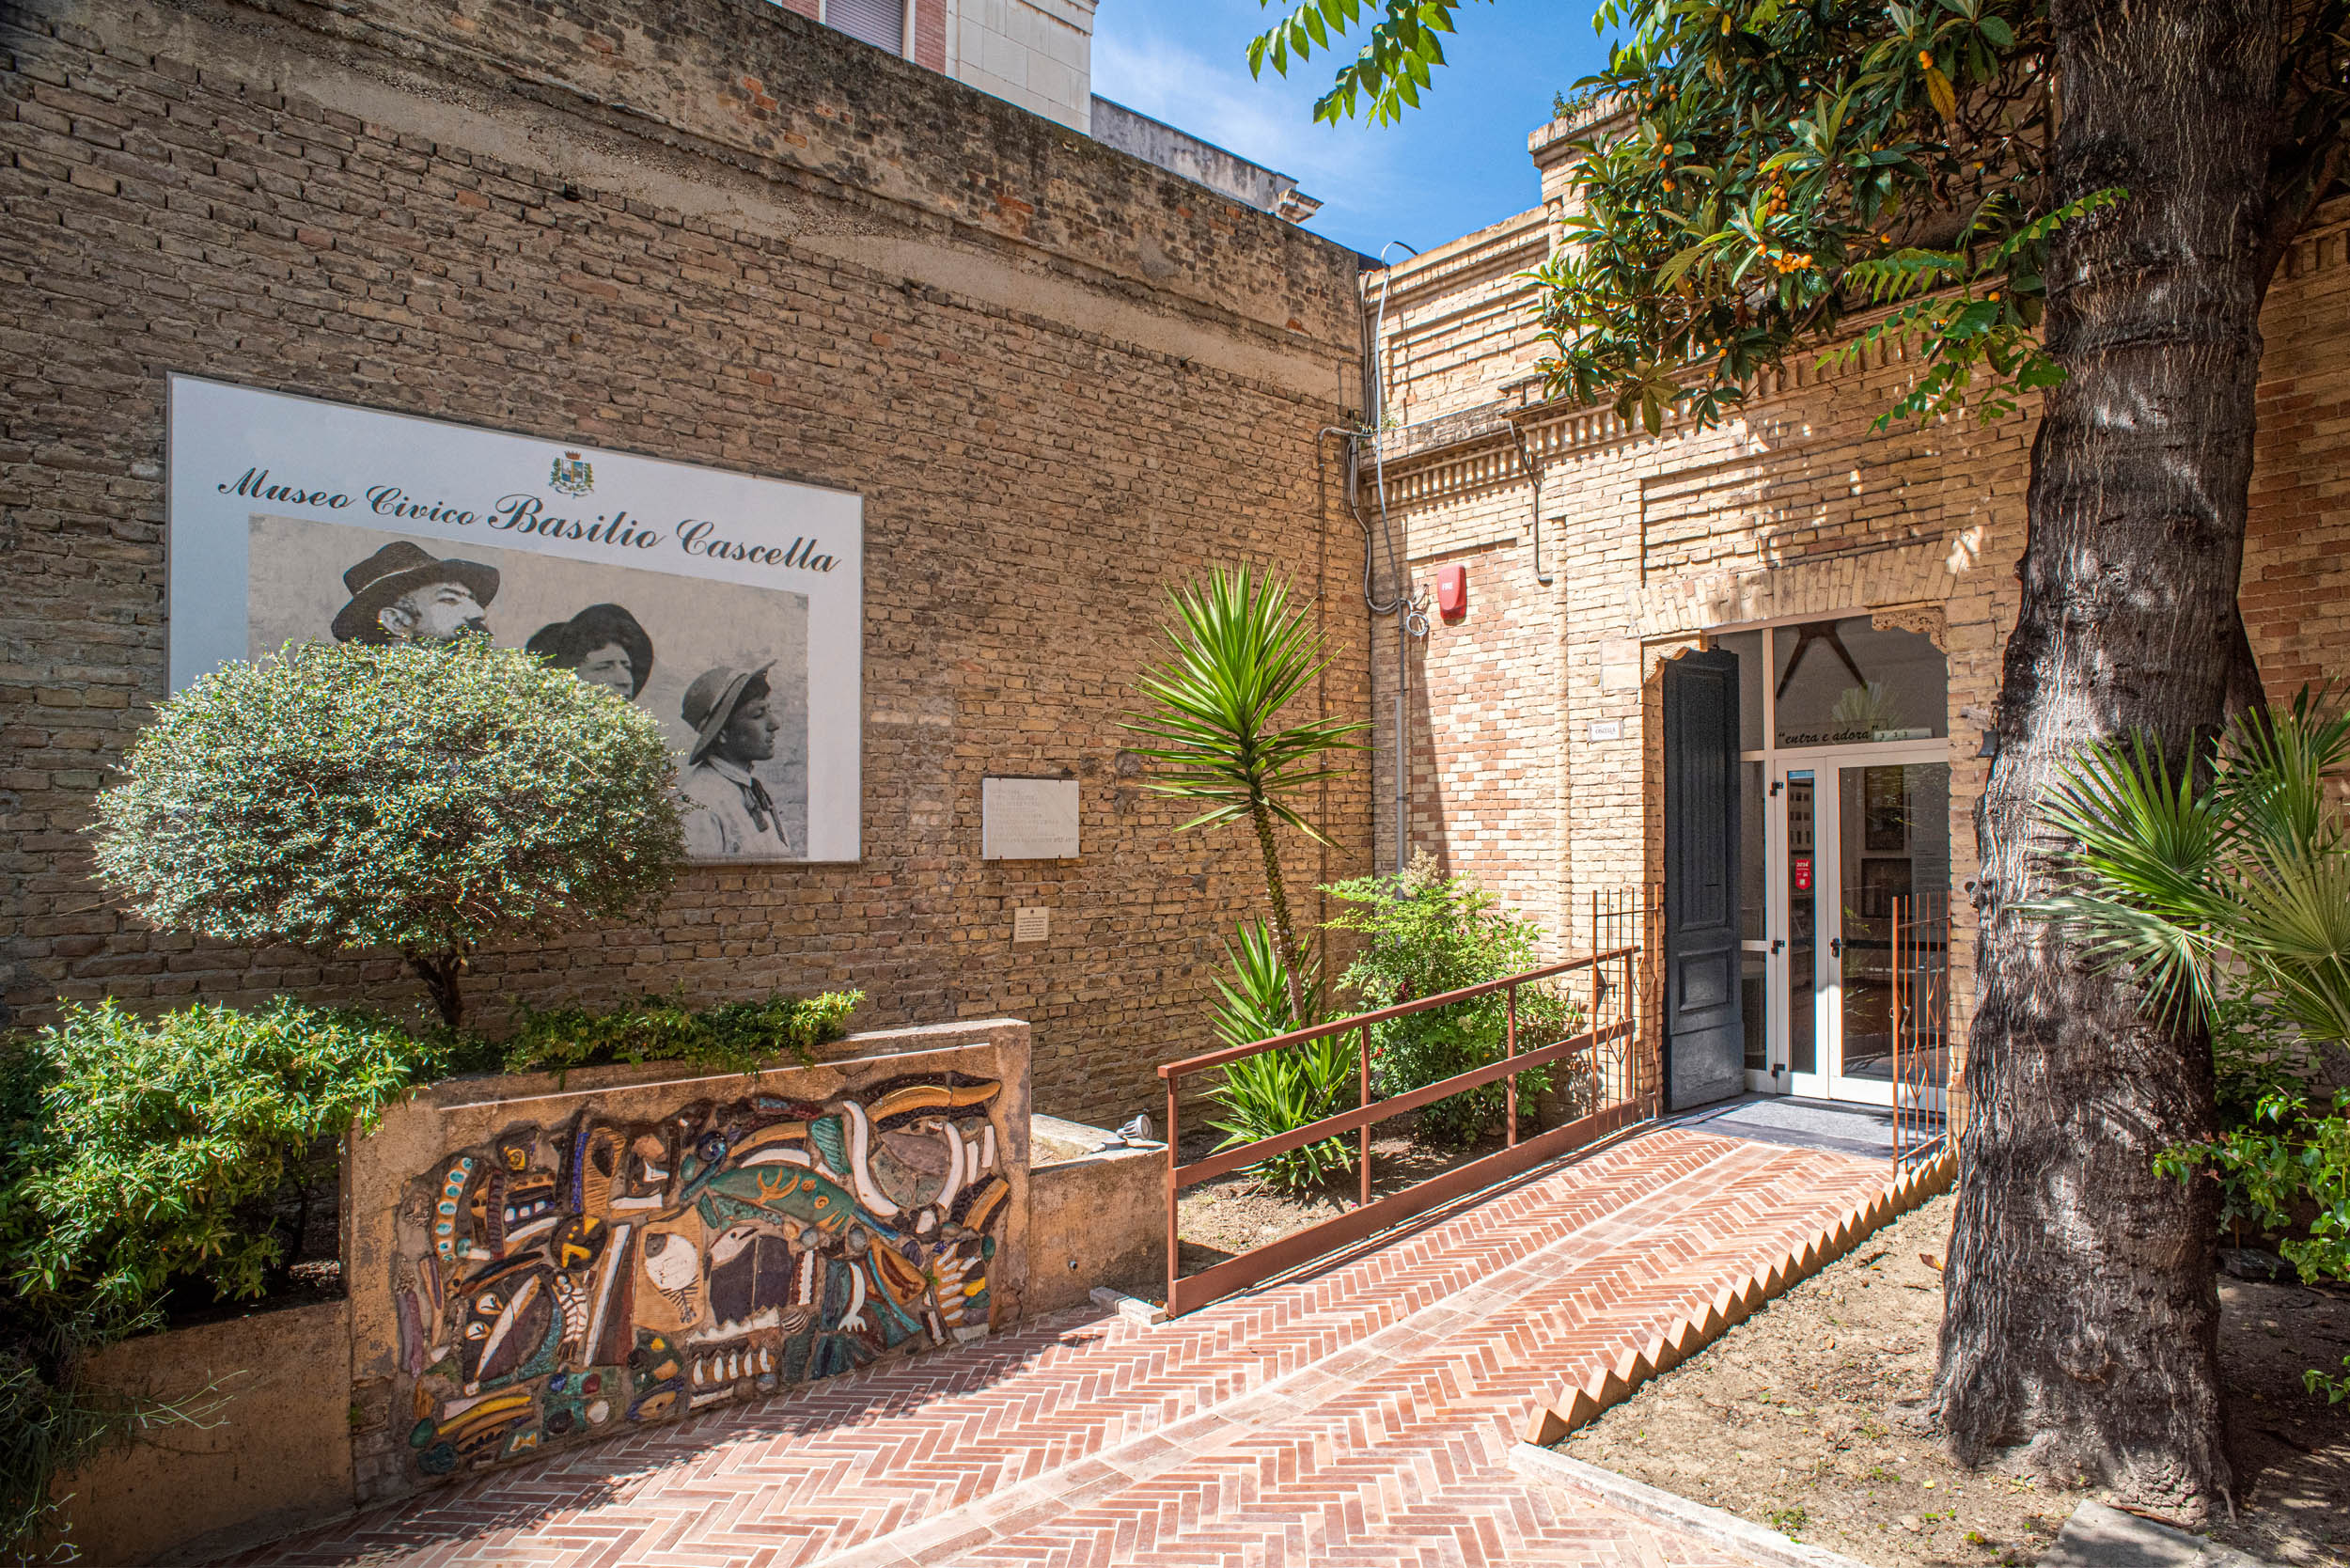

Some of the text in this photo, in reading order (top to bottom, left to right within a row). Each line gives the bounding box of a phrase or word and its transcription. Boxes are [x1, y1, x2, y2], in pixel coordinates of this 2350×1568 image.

[217, 466, 842, 573] Museo Civico Basilio Cascella
[1822, 733, 1829, 742] e
